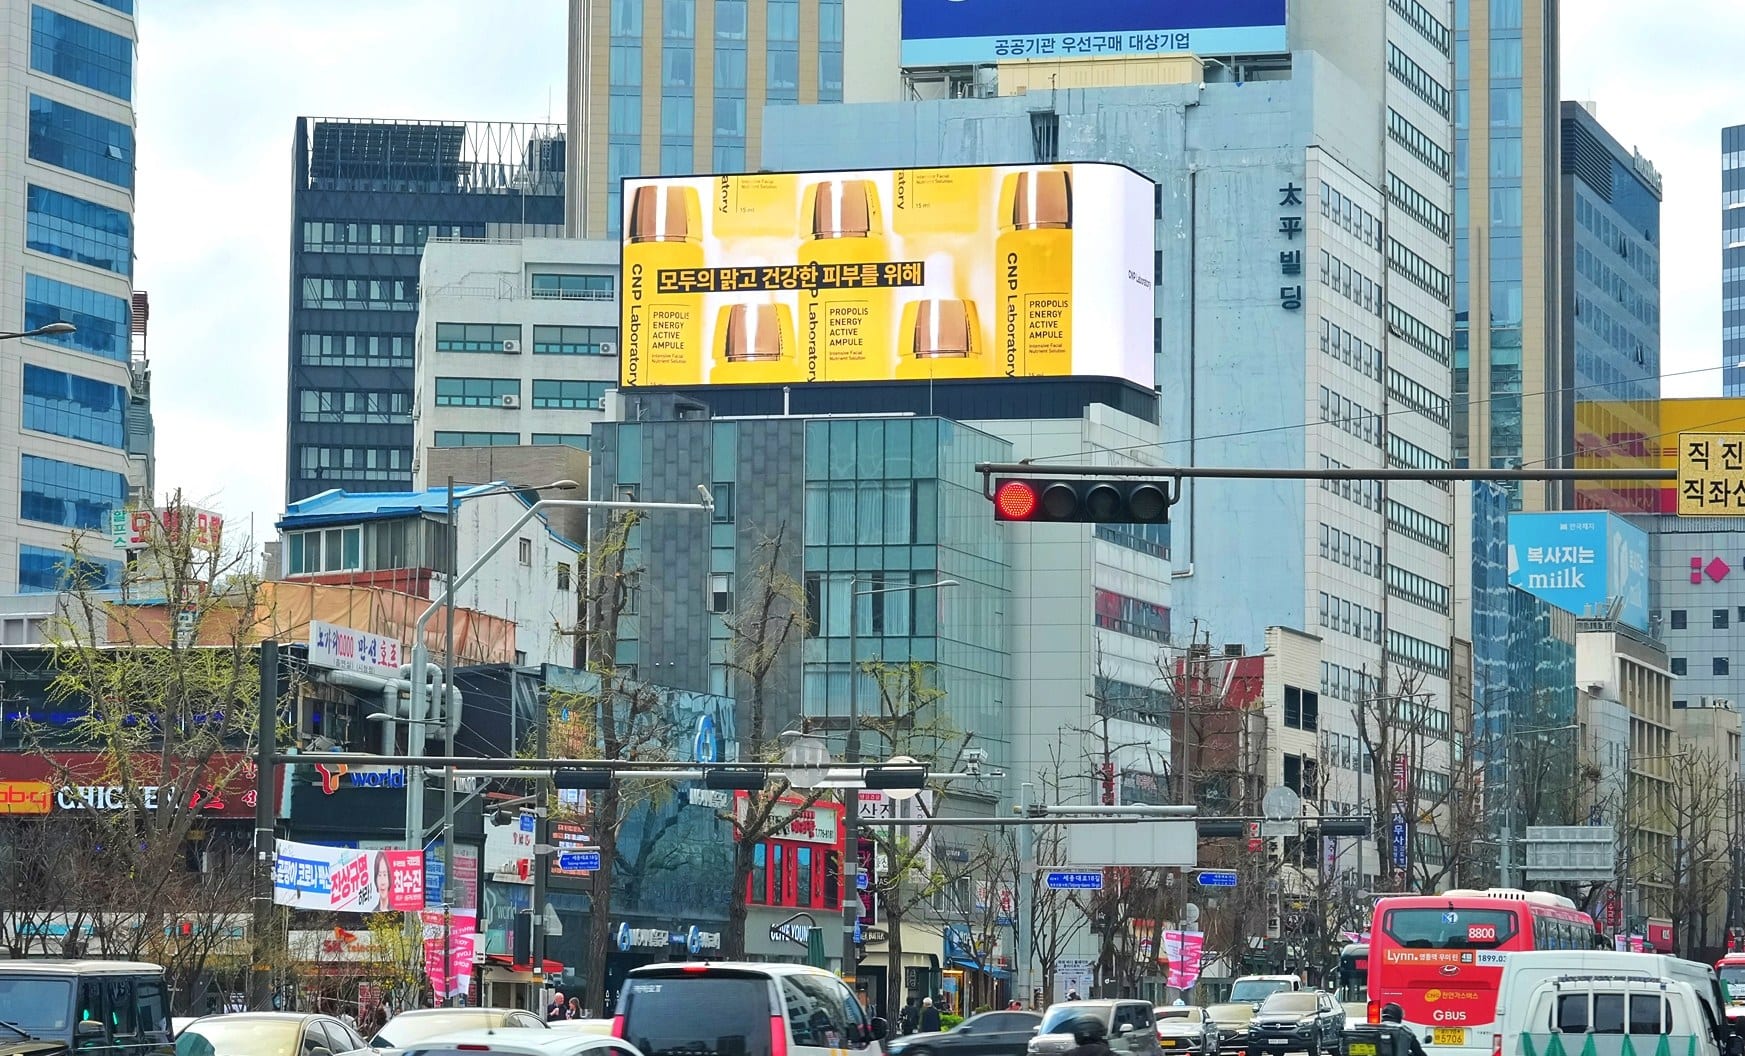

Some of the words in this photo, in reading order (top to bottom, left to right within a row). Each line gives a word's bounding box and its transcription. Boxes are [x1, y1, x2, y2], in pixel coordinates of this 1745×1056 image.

[995, 38, 1055, 55] 공공기관
[1062, 35, 1122, 53] 우선구매
[1129, 33, 1190, 50] 대상기업
[1279, 182, 1302, 310] 太平빌딩
[660, 269, 715, 291] 모두의
[720, 268, 757, 290] 맑고
[762, 266, 818, 289] 건강한
[822, 264, 879, 287] 피부를
[884, 262, 922, 286] 위해
[1007, 252, 1018, 290] CNP
[632, 263, 643, 301] CNP
[829, 307, 868, 316] PROPOLIS
[1029, 300, 1068, 308] PROPOLIS
[652, 311, 690, 320] PROPOLIS
[829, 318, 863, 326] ENERGY
[652, 321, 684, 330] ENERGY
[829, 328, 858, 336] ACTIVE
[652, 331, 680, 340] ACTIVE
[807, 302, 819, 383] Laboratory
[829, 338, 863, 346] AMPULE
[1005, 295, 1018, 377] Laboratory
[1029, 331, 1063, 339] AMPULE
[626, 304, 643, 387] Laboratory
[652, 341, 684, 350] AMPULE
[1528, 546, 1595, 564] 복사지는
[1528, 567, 1586, 589] miilk
[350, 768, 405, 788] world
[297, 860, 318, 887] 코로나
[330, 854, 369, 904] 진상규명
[394, 870, 422, 893] 최수진
[791, 924, 811, 942] YOUN
[1468, 928, 1495, 939] 8800
[1442, 991, 1479, 1000] 천연가스버스
[1441, 1035, 1462, 1044] 5706
